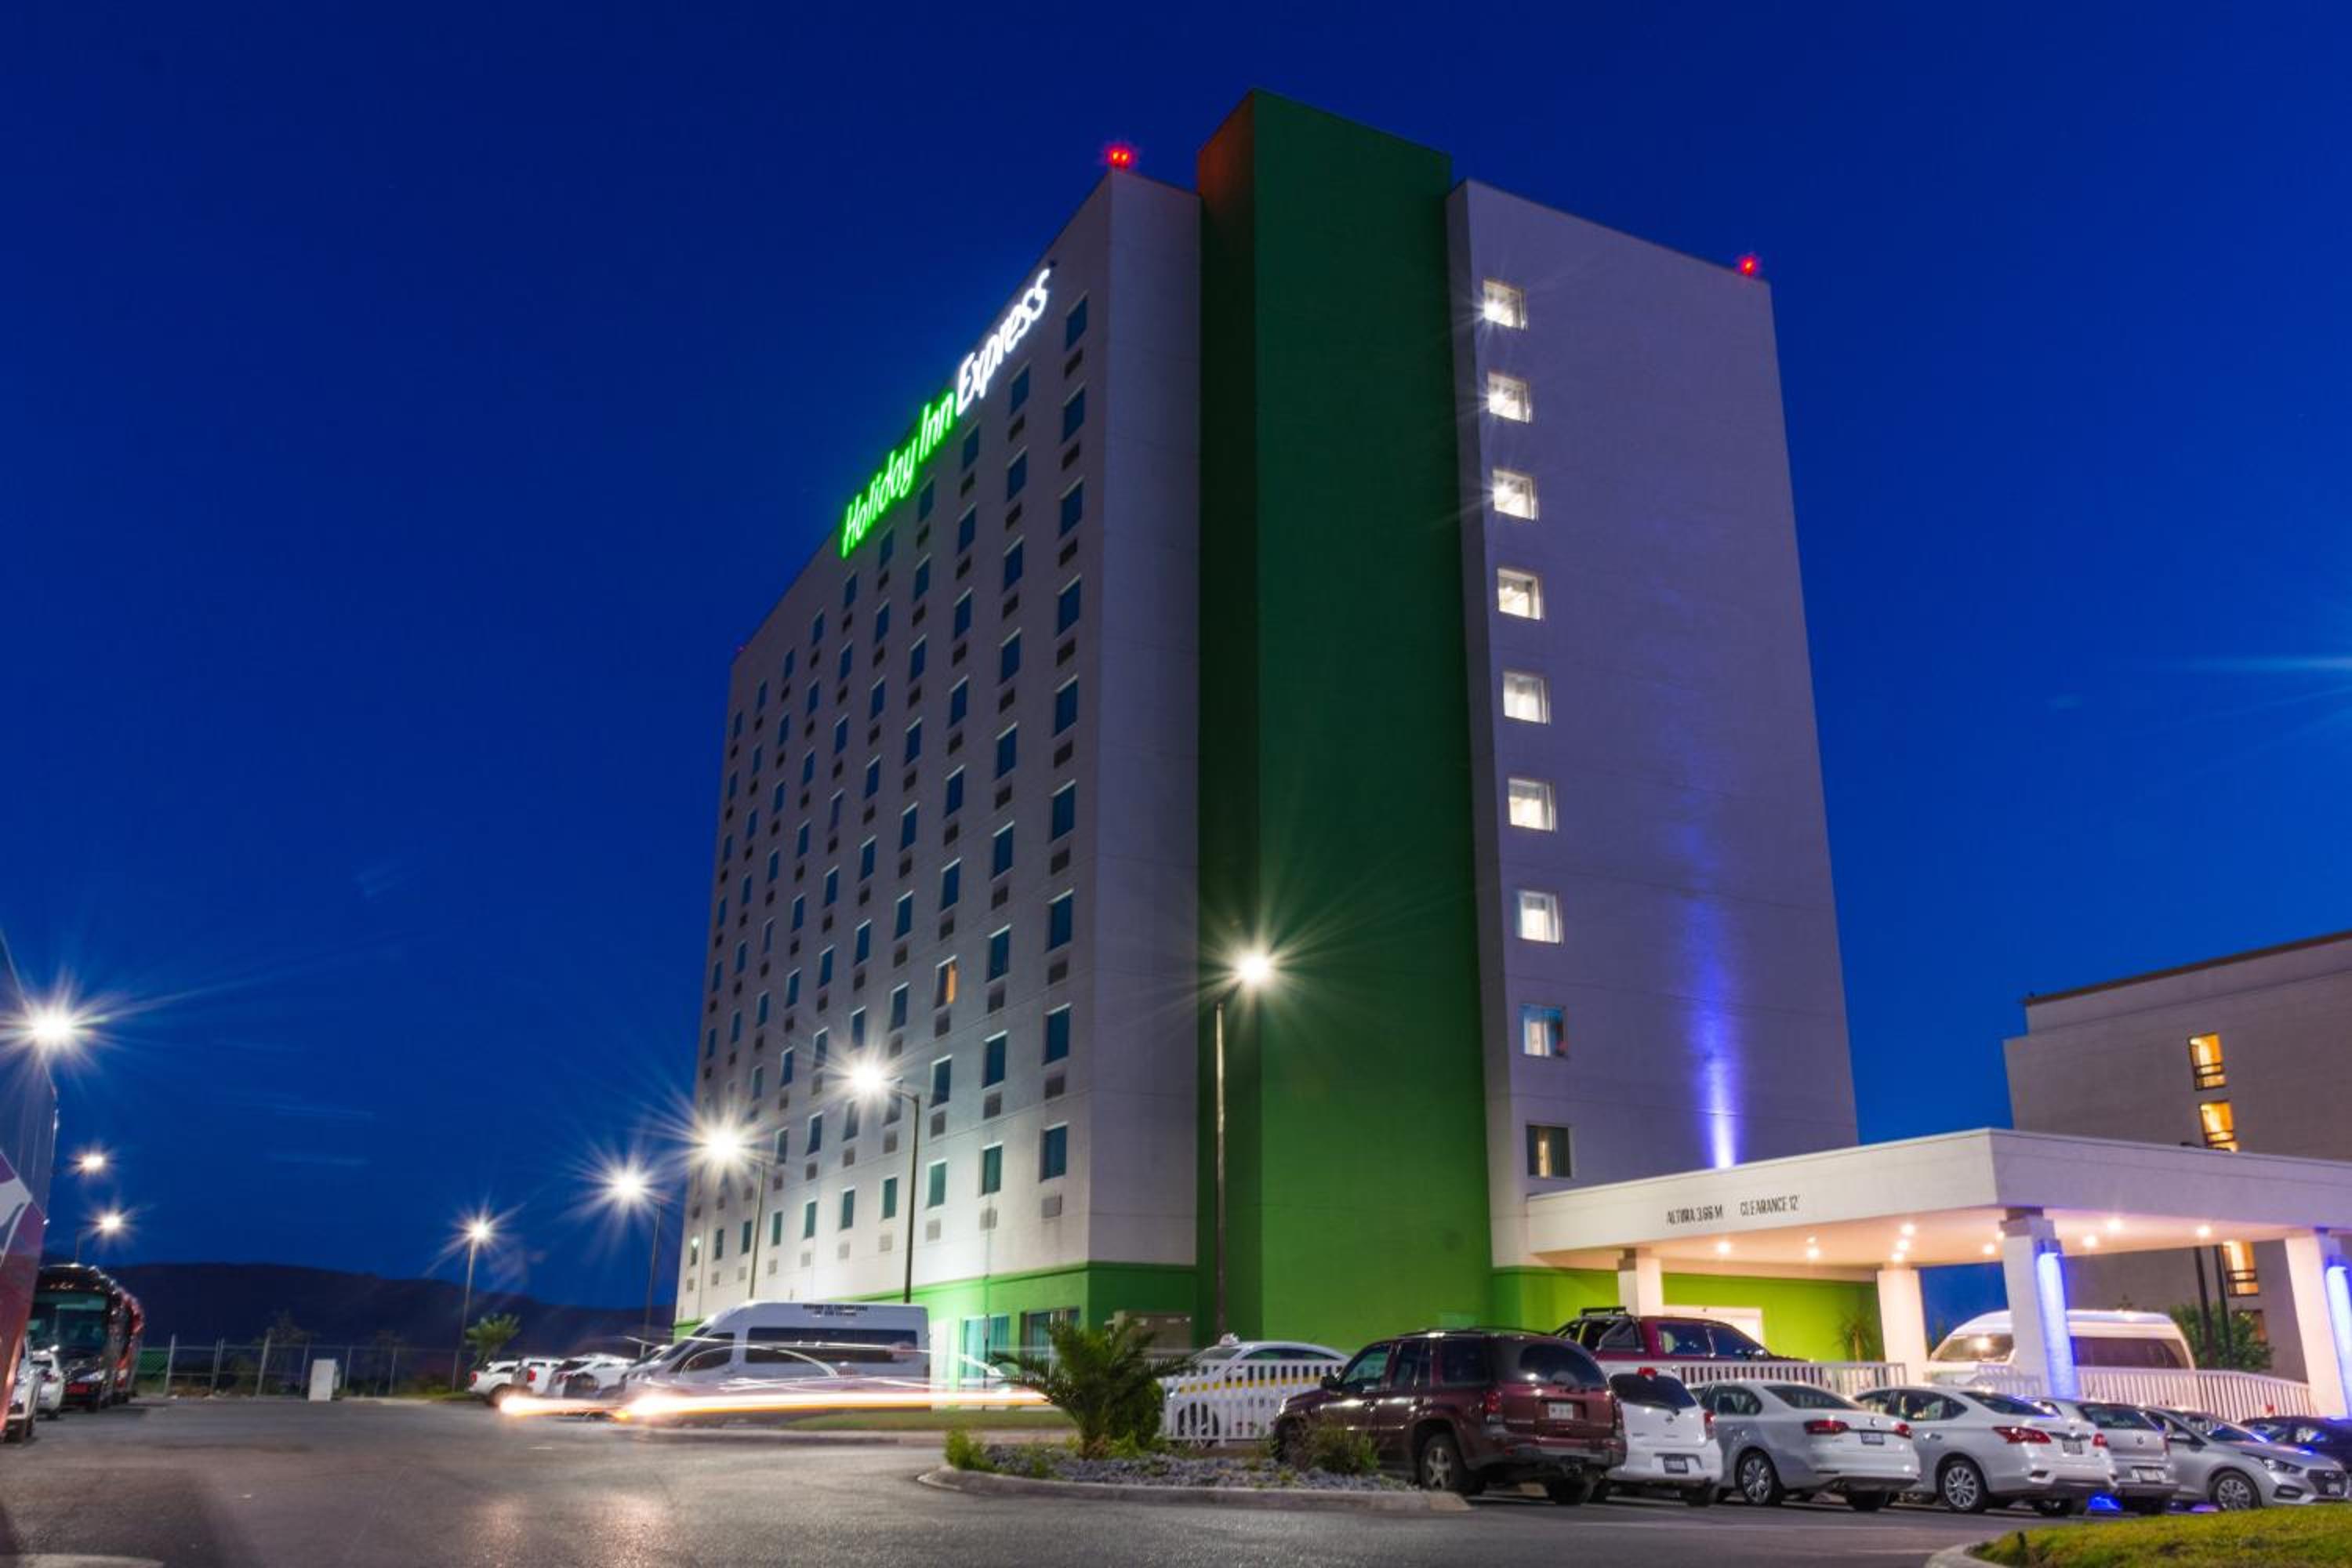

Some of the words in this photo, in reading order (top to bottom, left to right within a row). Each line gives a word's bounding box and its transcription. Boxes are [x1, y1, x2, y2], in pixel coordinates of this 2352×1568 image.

[841, 436, 918, 558] Holiday
[918, 391, 955, 463] Inn
[955, 268, 1051, 417] Express
[1740, 1196, 1788, 1216] CLEARANCE
